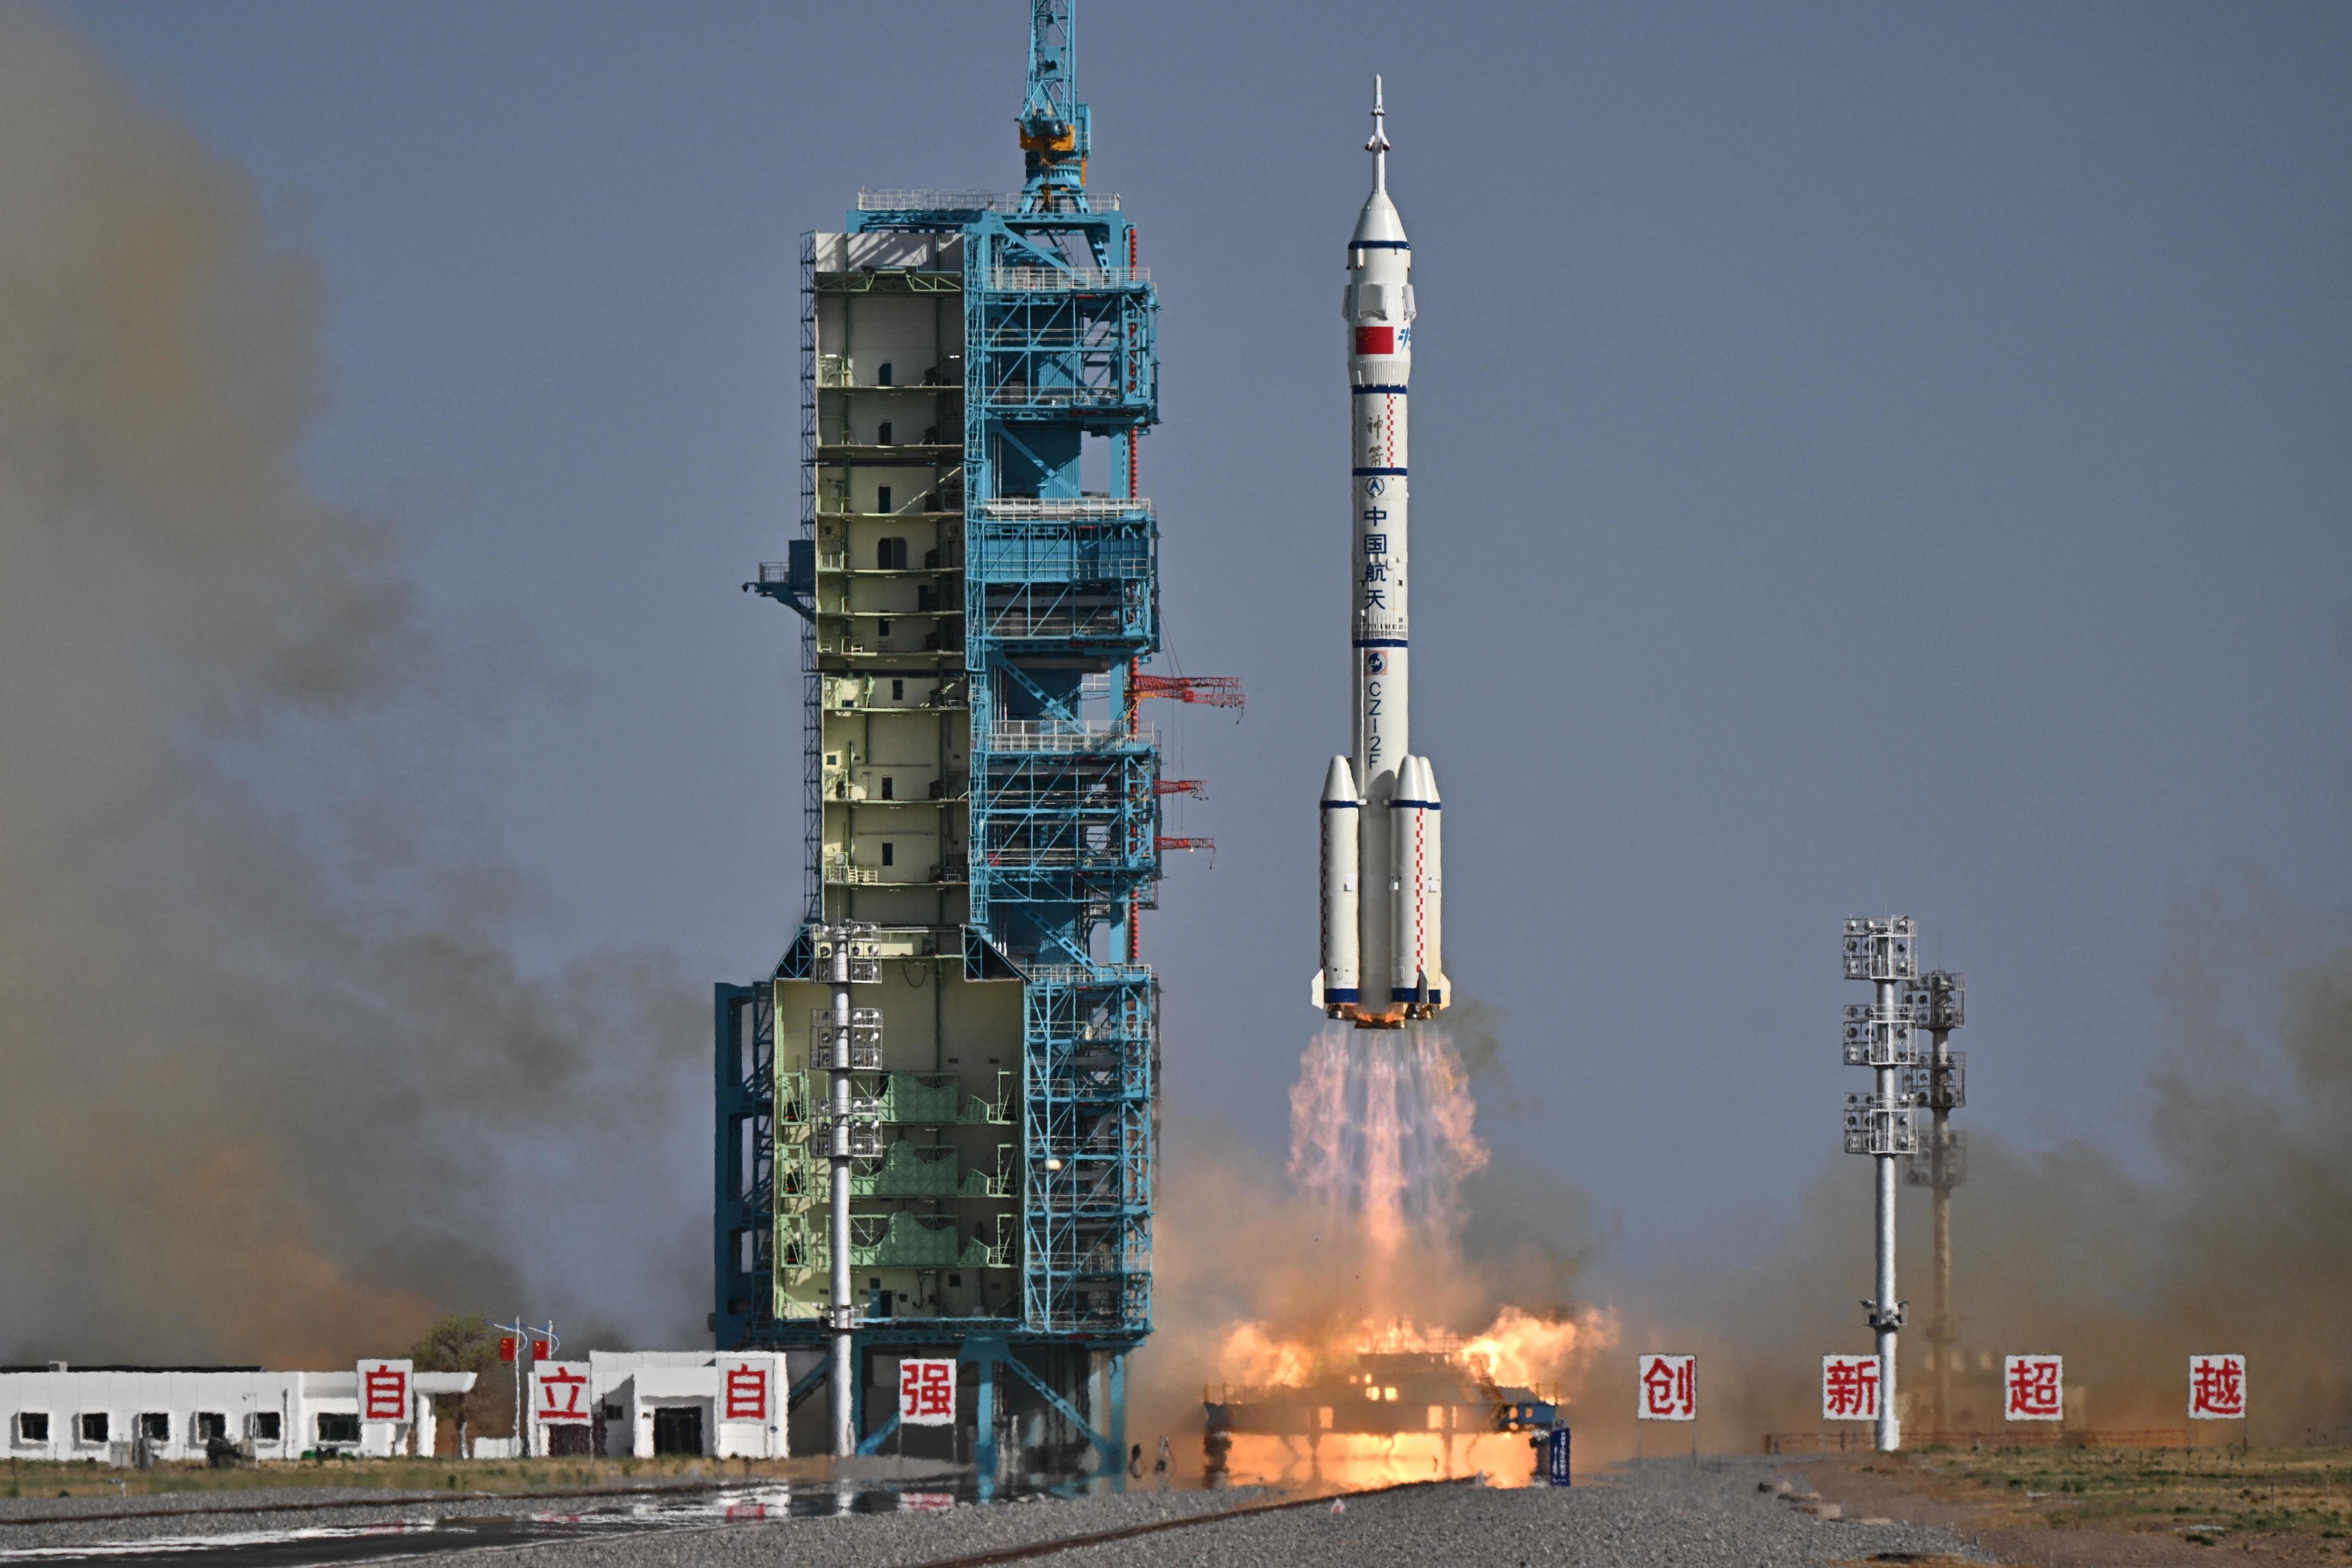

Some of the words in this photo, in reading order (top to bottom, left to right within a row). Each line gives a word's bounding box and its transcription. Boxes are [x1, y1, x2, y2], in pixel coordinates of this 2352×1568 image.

[1364, 505, 1387, 610] 中国航天
[366, 1365, 405, 1419] 自
[538, 1367, 589, 1419] 立
[727, 1364, 765, 1419] 自
[900, 1364, 952, 1416] 强
[1644, 1358, 1694, 1415] 创
[1827, 1360, 1878, 1415] 新
[2010, 1360, 2060, 1415] 超
[2194, 1359, 2242, 1415] 越
